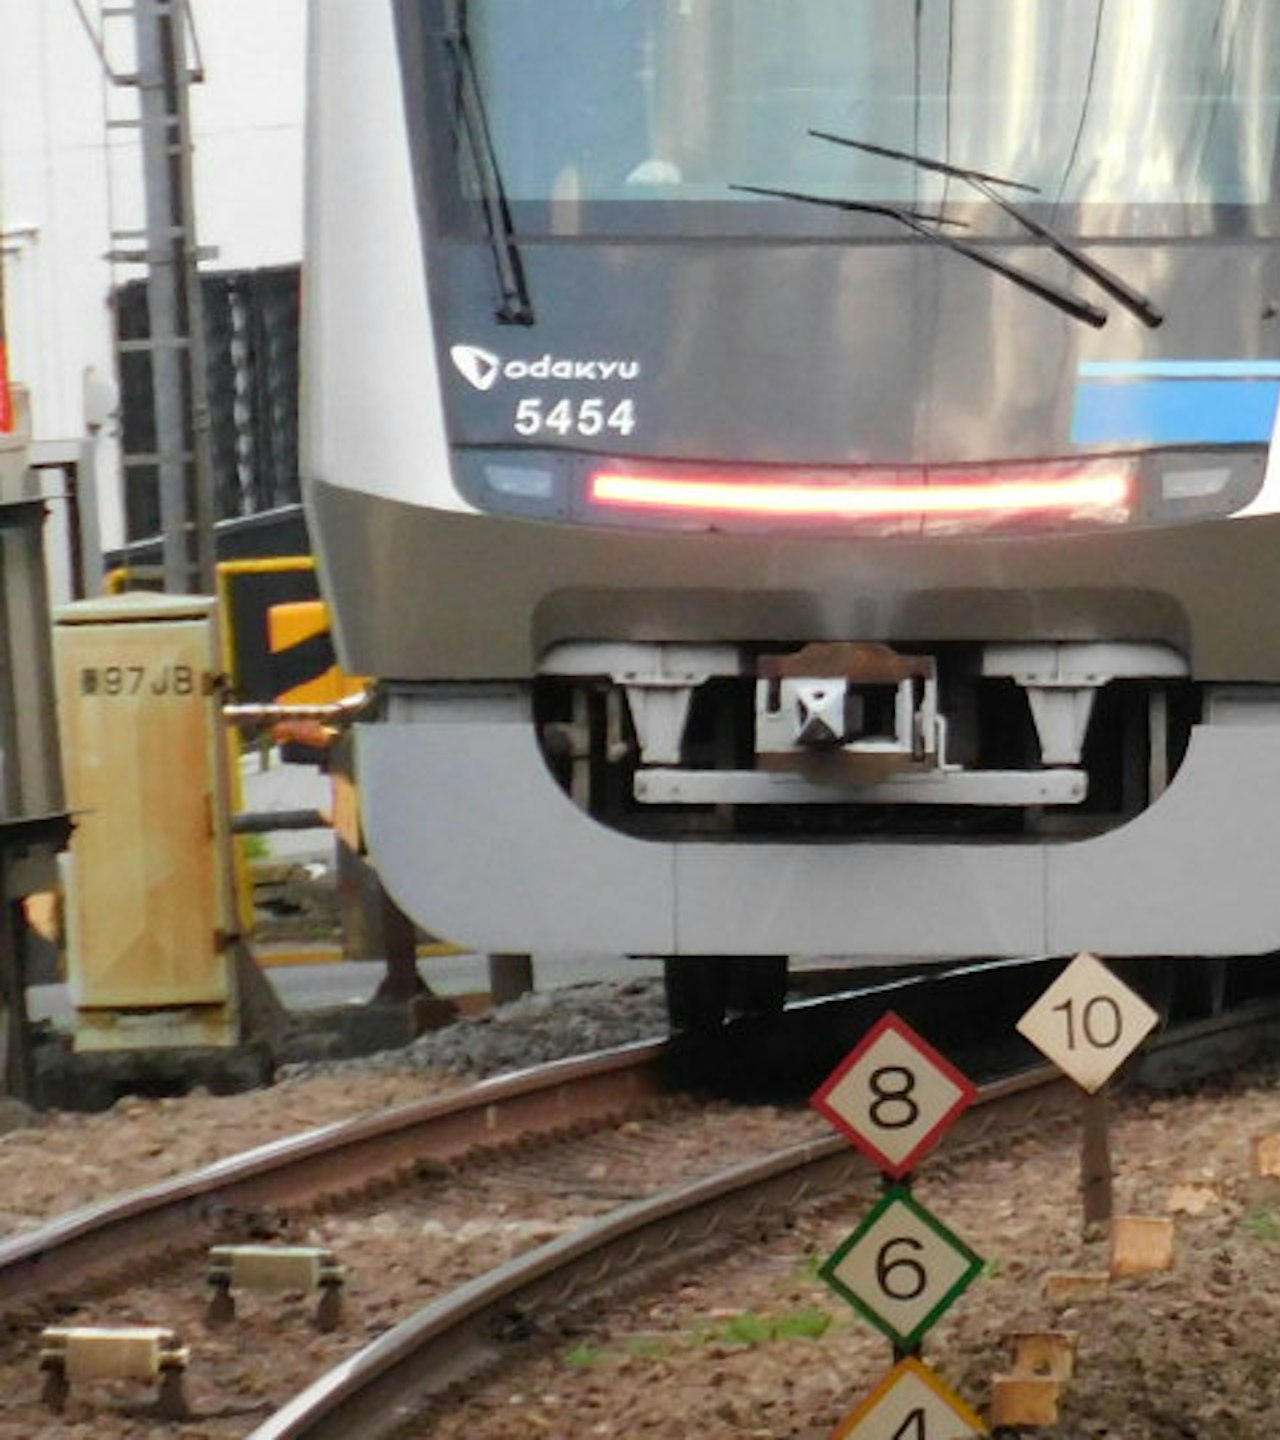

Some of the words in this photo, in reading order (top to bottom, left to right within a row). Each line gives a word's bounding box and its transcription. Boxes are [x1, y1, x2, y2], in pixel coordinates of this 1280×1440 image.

[503, 354, 641, 380] odakyu
[513, 397, 637, 436] 5454
[1052, 995, 1124, 1052] 10
[867, 1066, 921, 1129] 8
[875, 1237, 928, 1301] 6
